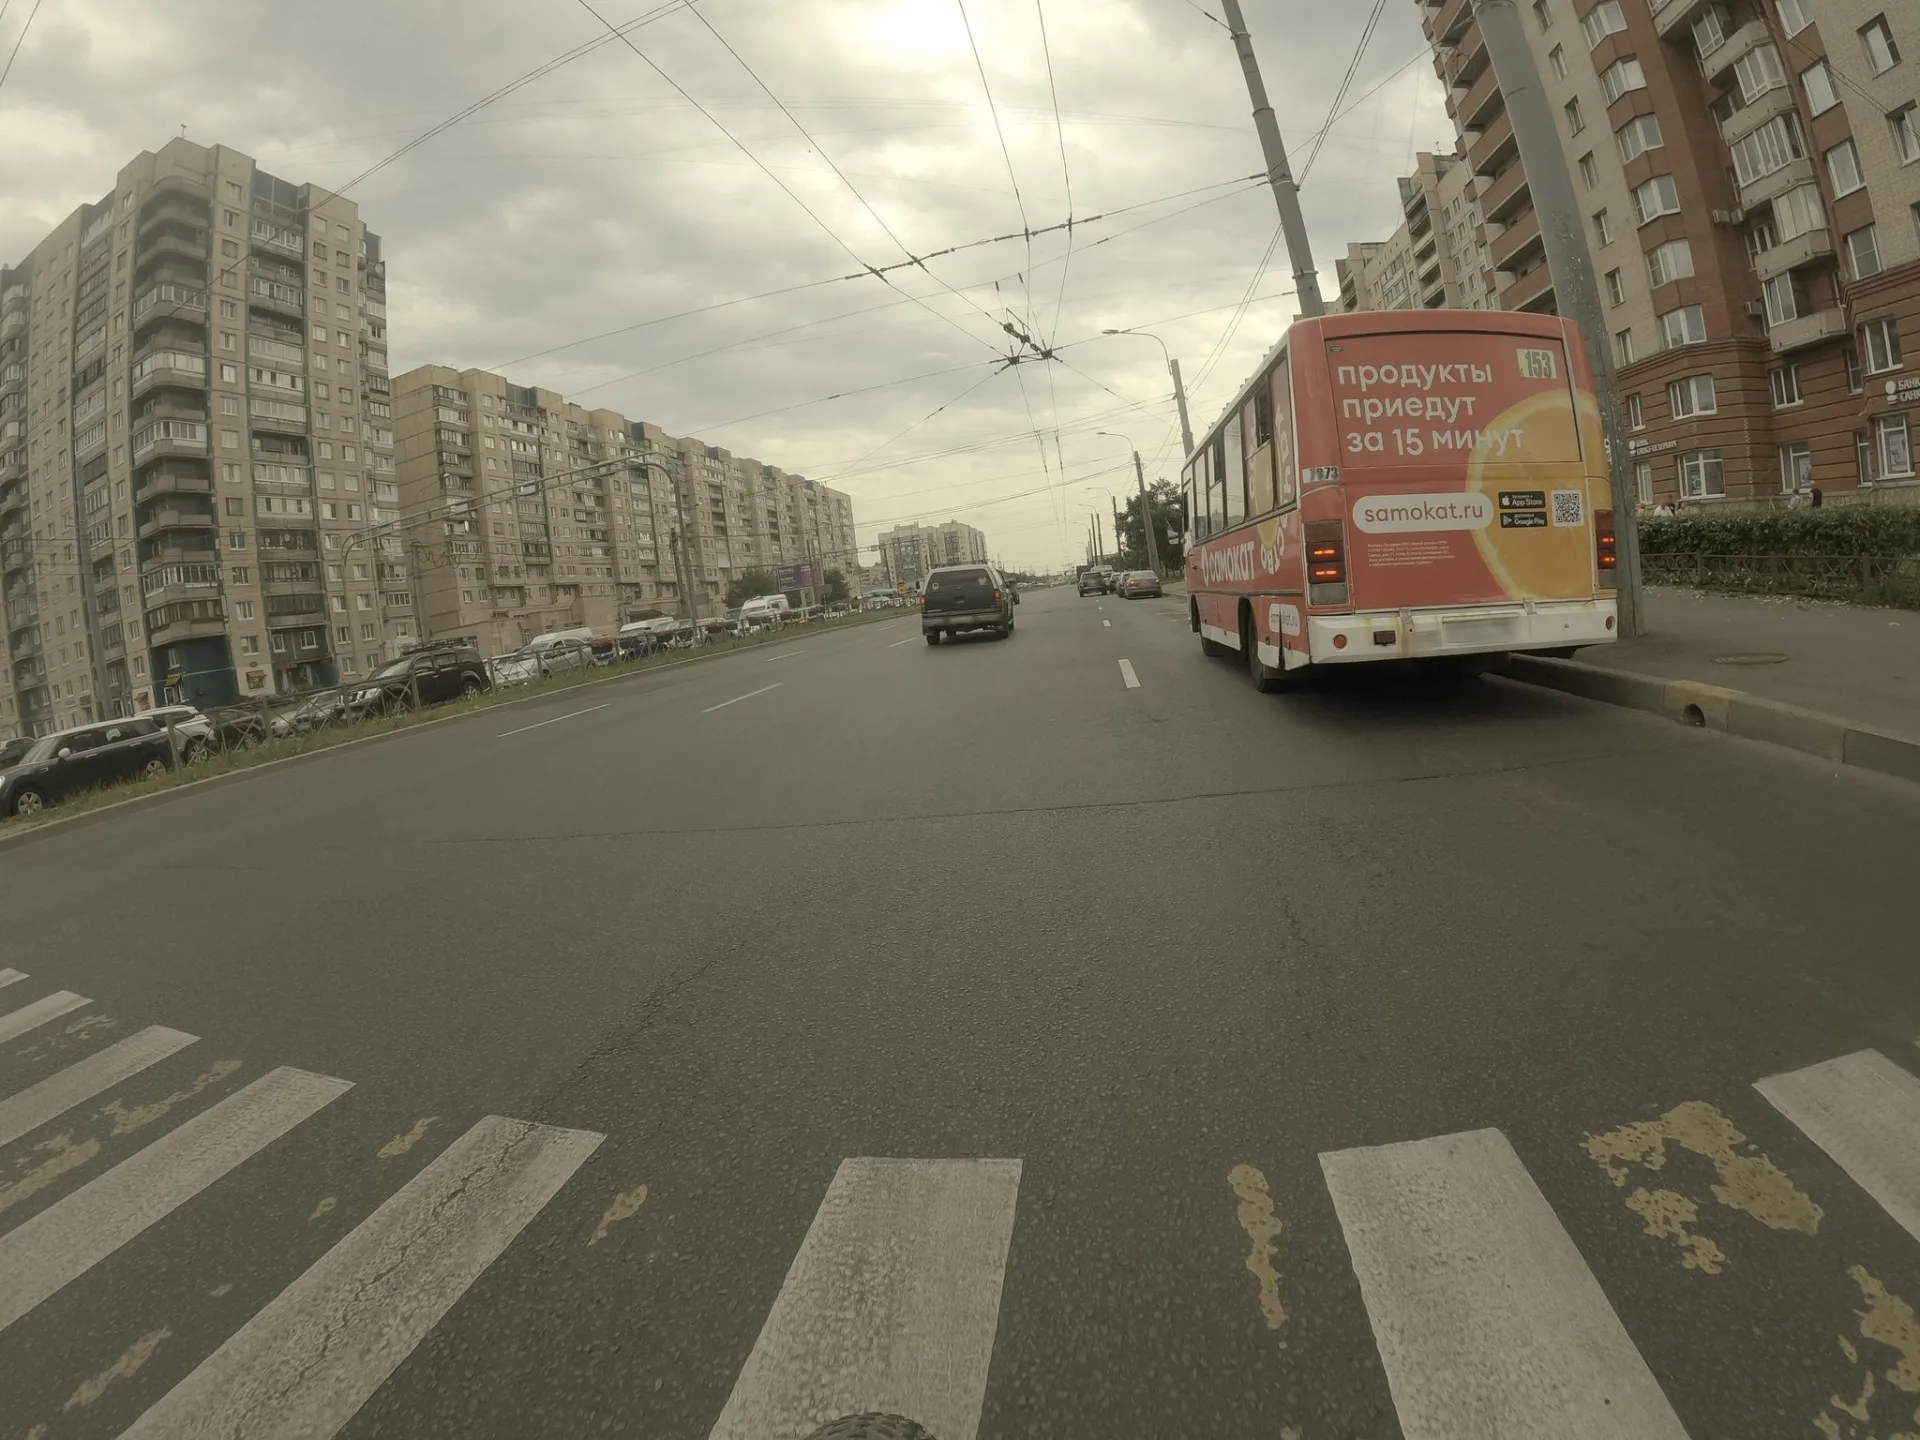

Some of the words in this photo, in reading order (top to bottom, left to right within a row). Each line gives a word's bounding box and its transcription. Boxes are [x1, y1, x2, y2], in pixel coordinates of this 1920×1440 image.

[1337, 364, 1493, 391] продукты
[1524, 351, 1552, 378] 153
[1342, 396, 1476, 425] приедут
[1346, 431, 1385, 452] за
[1392, 428, 1424, 456] 15
[1431, 429, 1524, 456] минут
[1364, 501, 1484, 522] samokat.ru
[1512, 499, 1525, 507] App
[1526, 498, 1543, 506] Store
[1514, 517, 1534, 526] Google
[1209, 540, 1255, 583] самокат
